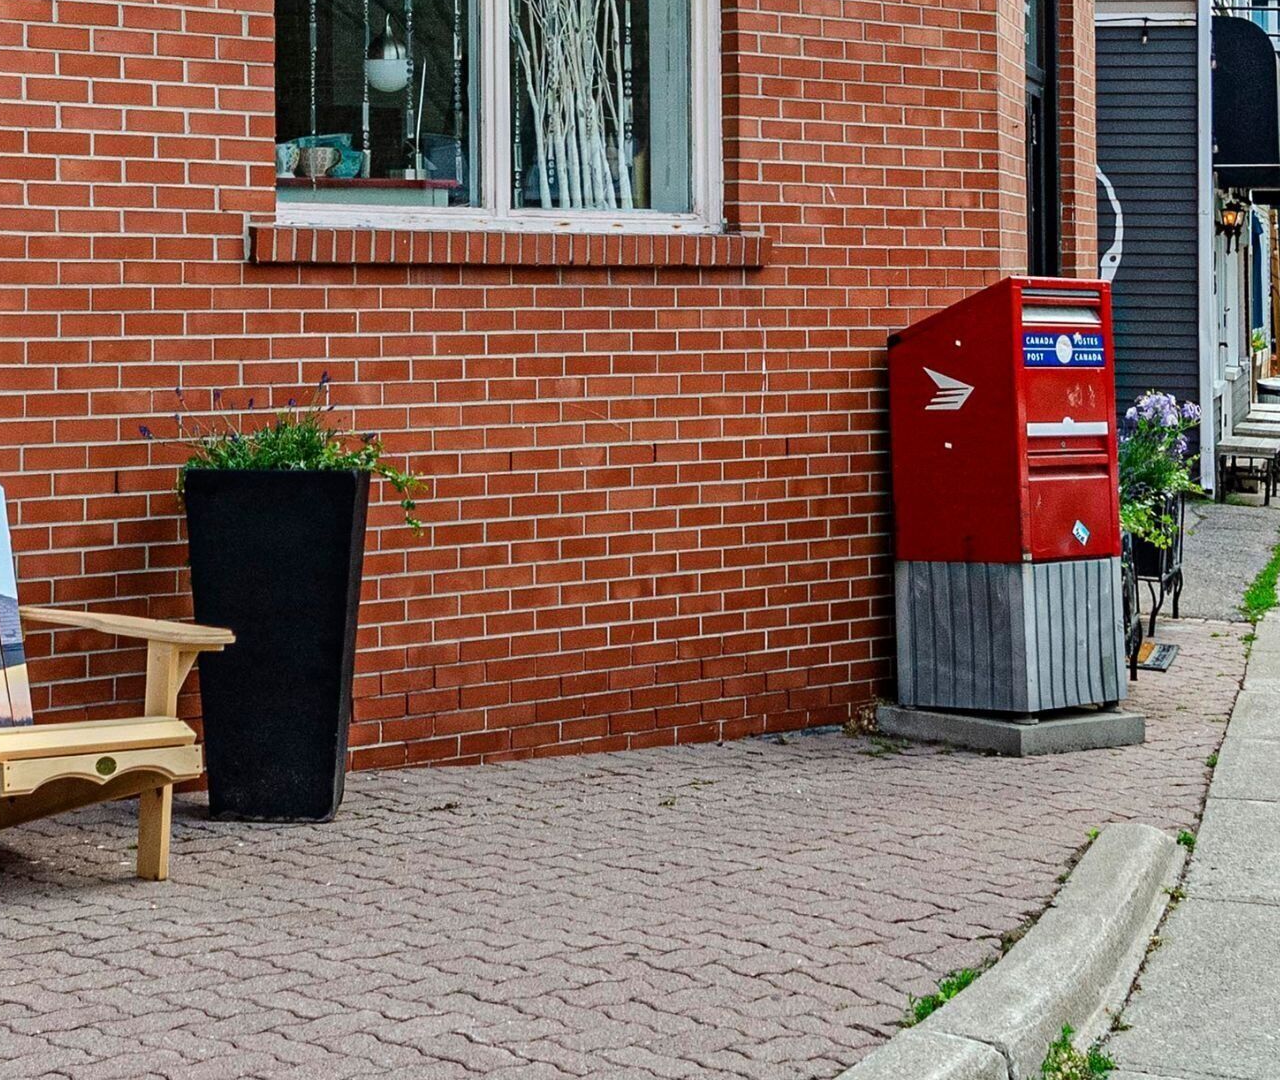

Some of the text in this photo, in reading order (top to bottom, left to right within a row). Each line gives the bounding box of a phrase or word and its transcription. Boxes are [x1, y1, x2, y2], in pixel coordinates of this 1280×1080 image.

[1025, 336, 1054, 345] CANADA
[1027, 352, 1102, 361] POST CANADA
